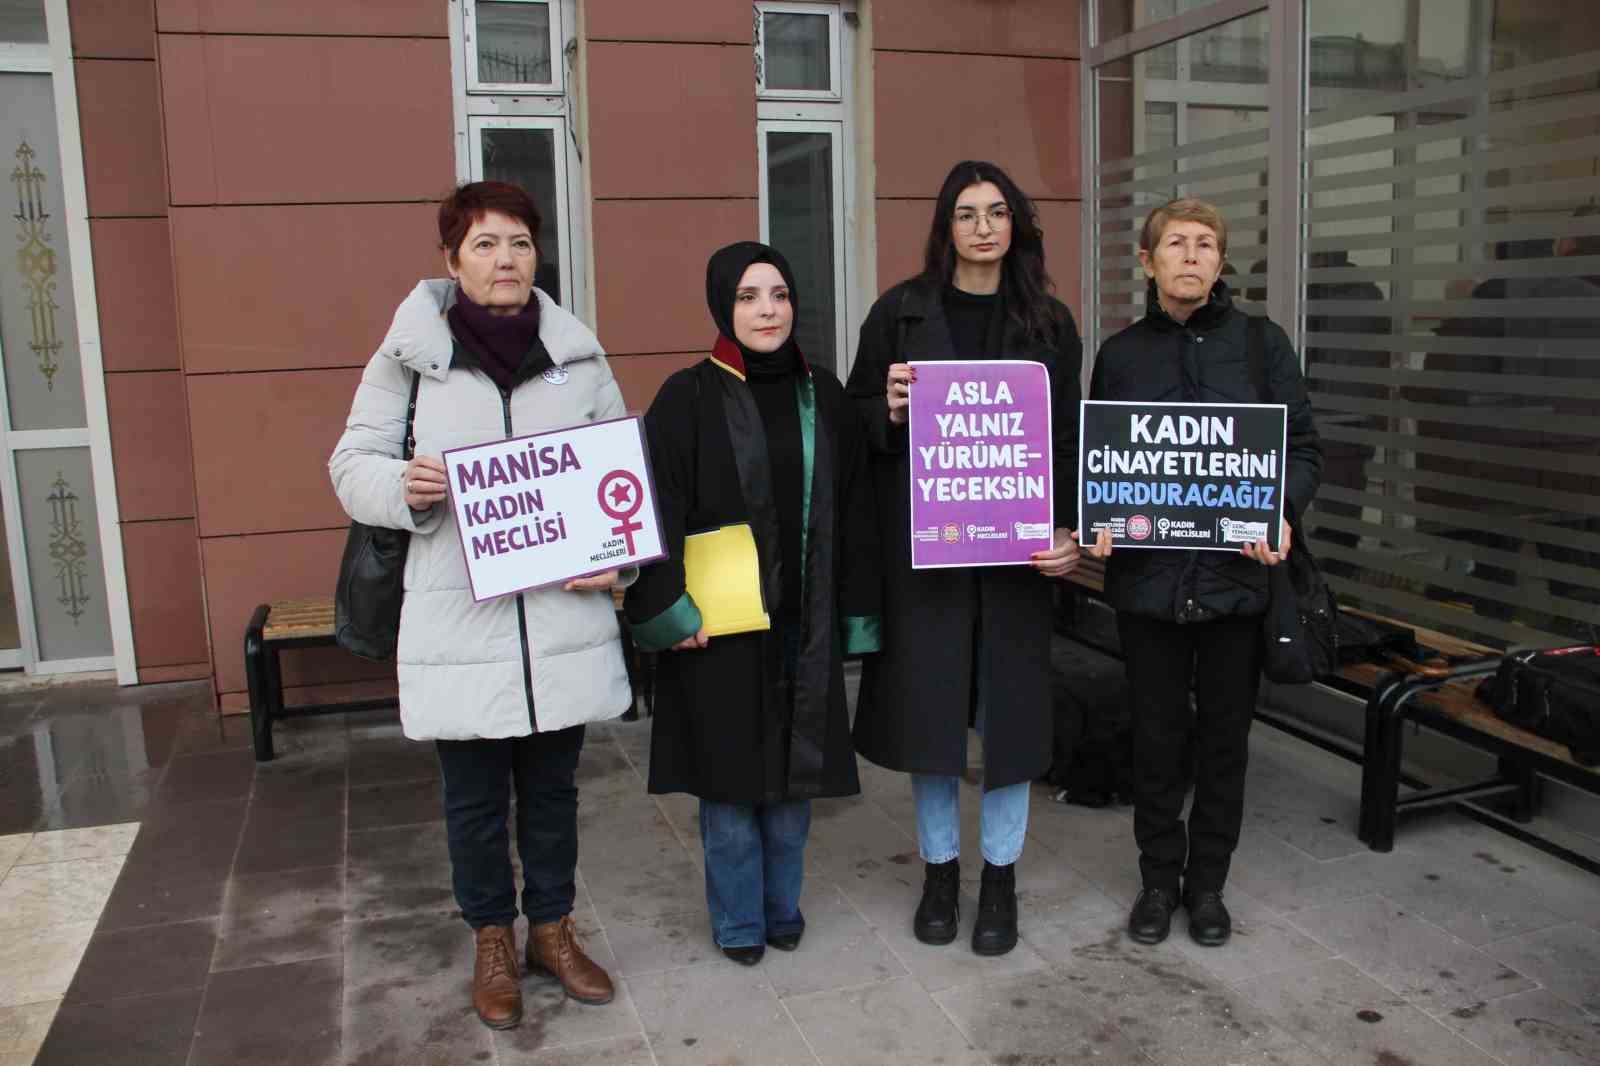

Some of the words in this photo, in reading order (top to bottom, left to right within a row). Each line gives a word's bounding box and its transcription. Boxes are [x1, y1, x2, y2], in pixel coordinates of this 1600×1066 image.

[945, 381, 1014, 406] ASLA
[935, 412, 1025, 438] YALNIZ
[1130, 413, 1235, 446] KADIN
[457, 442, 582, 493] MANİSA
[919, 441, 1042, 470] YÜRÜME-
[1087, 444, 1277, 479] CİNAYETLERİNİ
[918, 472, 1045, 502] YECEKSİN
[1086, 480, 1276, 510] DURDURACAĞIZ
[464, 489, 544, 527] KADIN
[471, 512, 567, 559] MECLİSİ
[1170, 520, 1195, 529] KADIN
